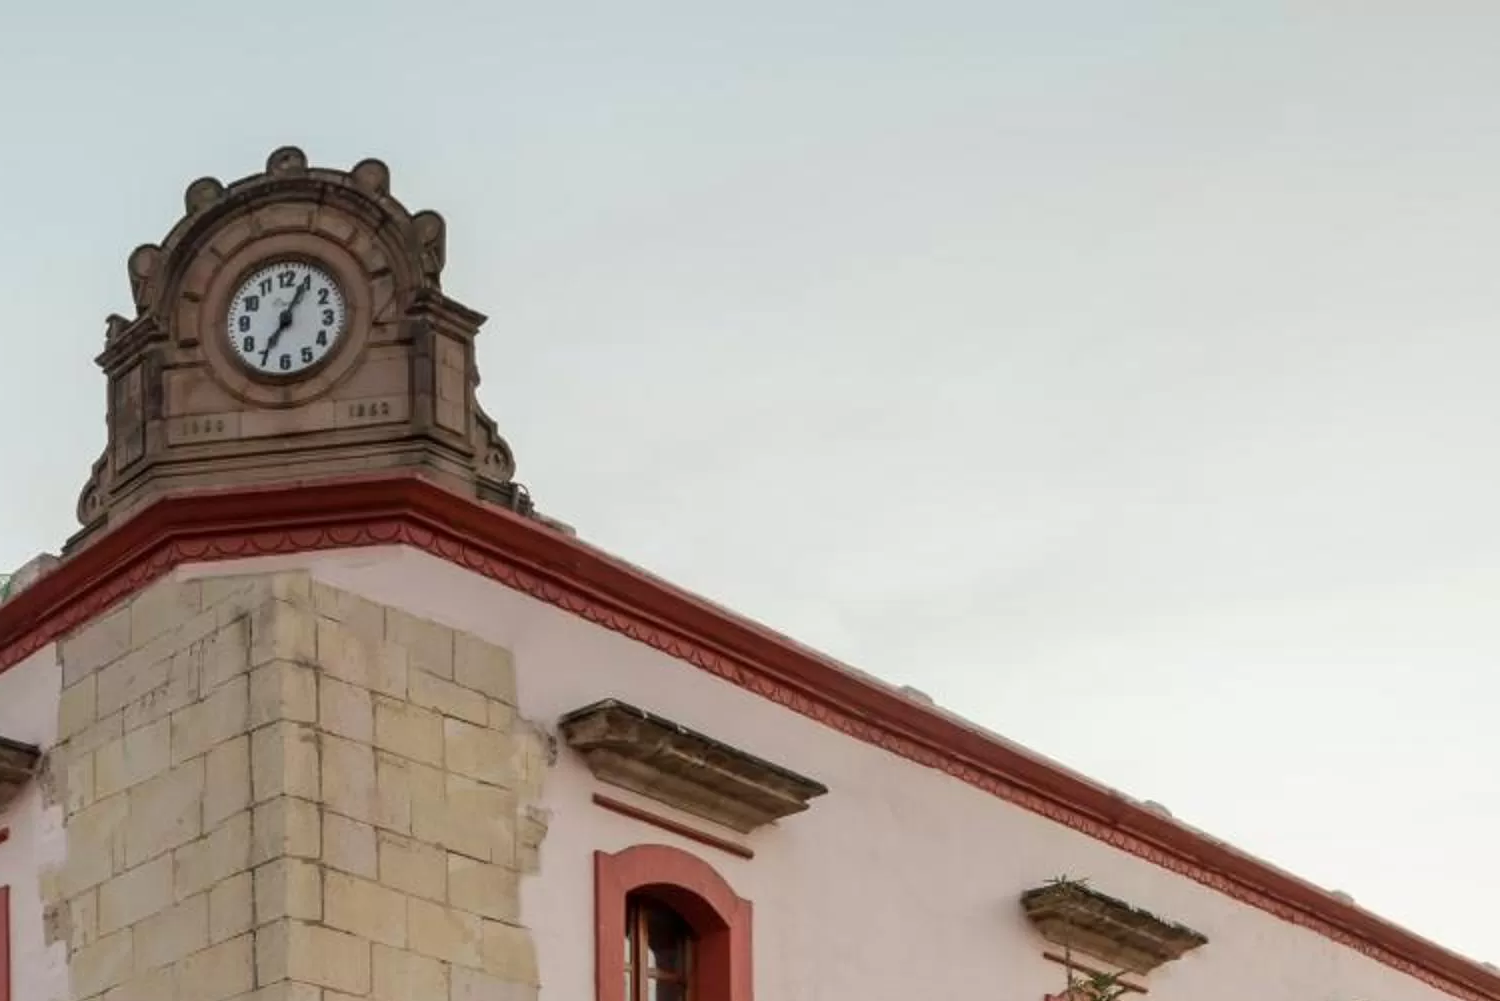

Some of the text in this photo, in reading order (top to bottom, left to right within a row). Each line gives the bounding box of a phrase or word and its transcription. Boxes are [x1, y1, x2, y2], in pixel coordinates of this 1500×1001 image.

[258, 277, 273, 297] 11
[277, 270, 296, 289] 12
[242, 295, 260, 312] 10
[316, 287, 329, 305] 2
[238, 315, 251, 333] 9
[322, 308, 334, 327] 3
[243, 335, 255, 353] 8
[316, 329, 328, 348] 4
[279, 353, 292, 370] 6
[301, 346, 314, 363] 5
